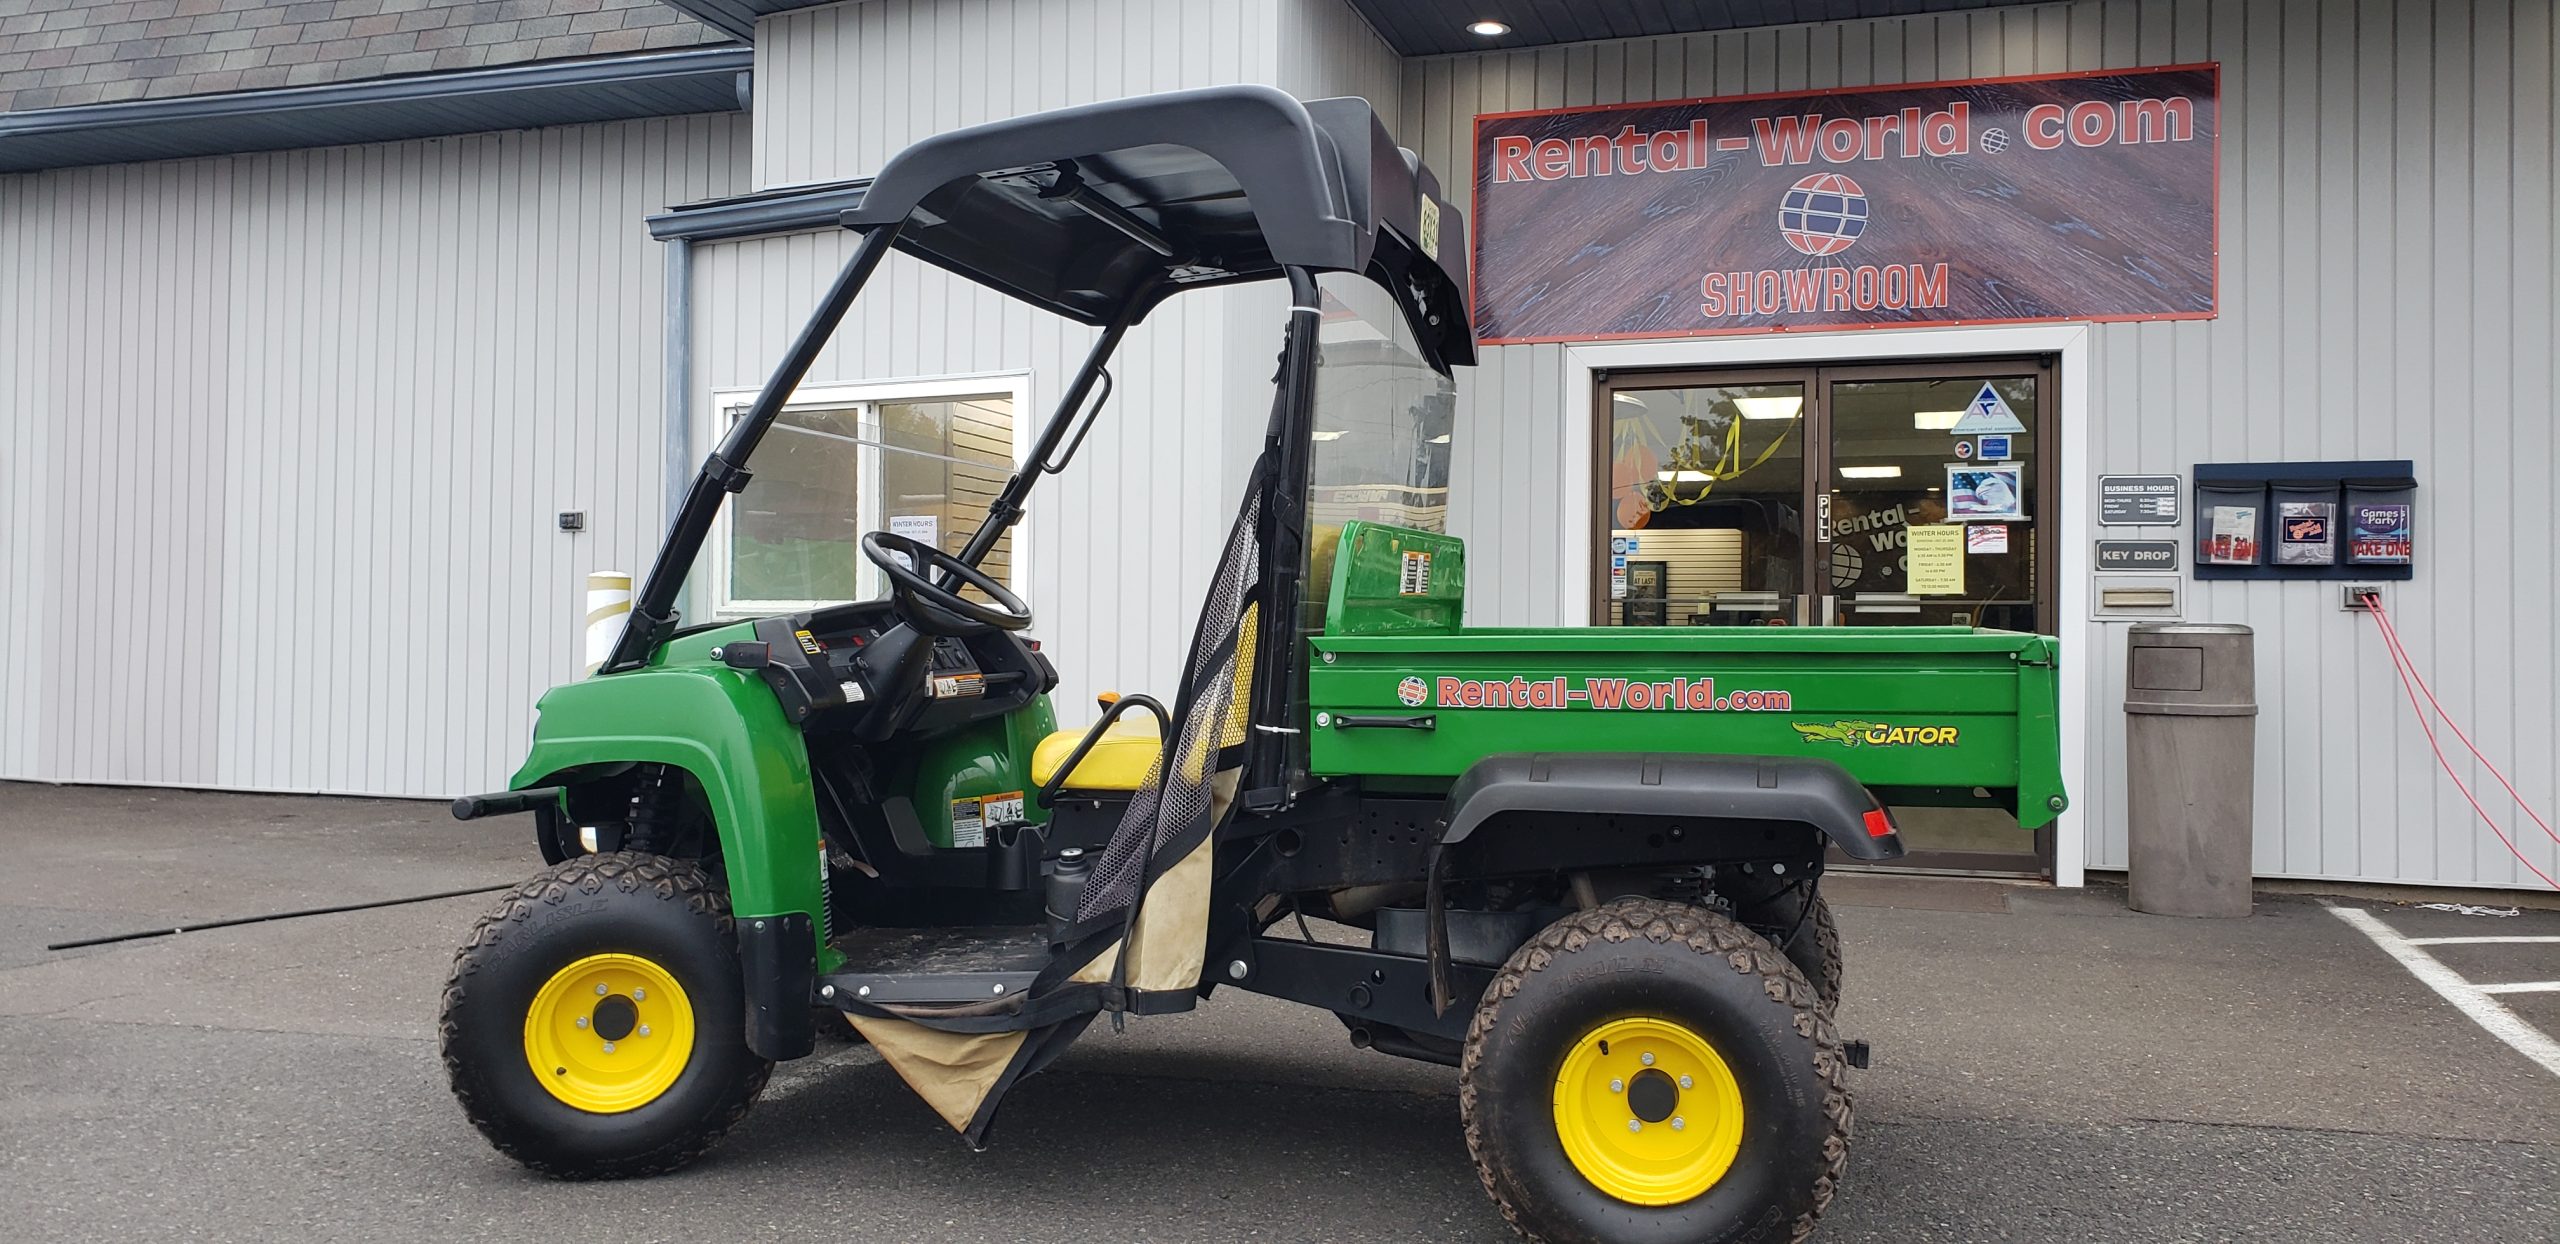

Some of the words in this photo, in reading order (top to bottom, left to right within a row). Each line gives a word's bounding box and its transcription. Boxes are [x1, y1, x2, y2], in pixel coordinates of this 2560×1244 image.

[1700, 262, 1949, 318] SHOWROOM
[1820, 498, 1828, 540] PULL
[2361, 509, 2399, 518] Games
[2368, 516, 2397, 526] Party
[2103, 551, 2129, 560] KEY
[2134, 551, 2170, 560] DROP
[2351, 541, 2382, 556] TAKE
[2386, 541, 2412, 557] ONE
[1864, 724, 1959, 746] GATOR
